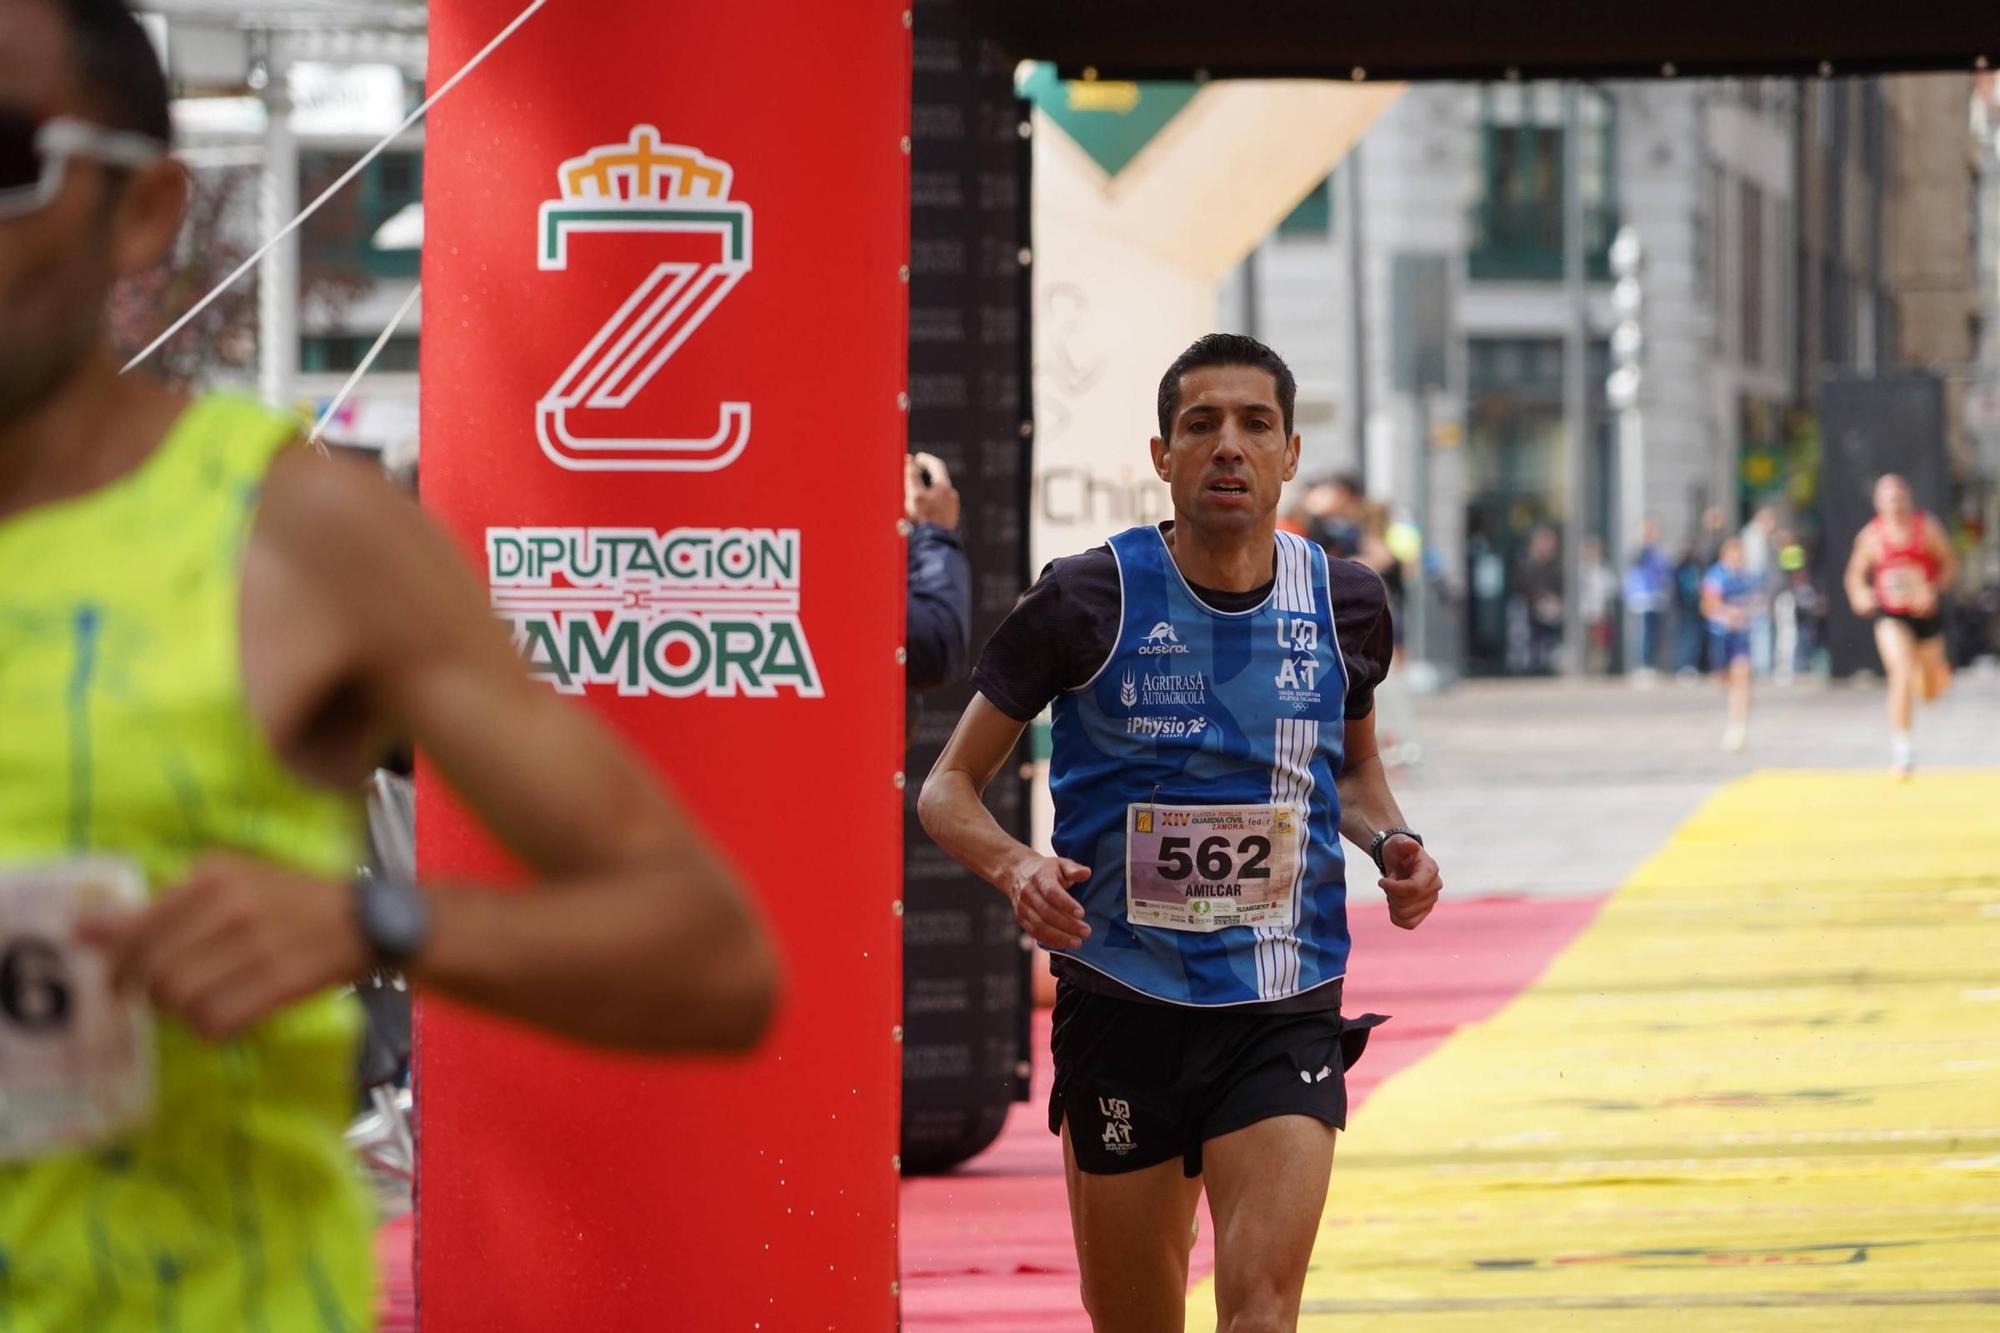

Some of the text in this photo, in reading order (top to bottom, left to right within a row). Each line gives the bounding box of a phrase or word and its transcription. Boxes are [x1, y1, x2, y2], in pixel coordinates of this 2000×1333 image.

[515, 619, 814, 688] AMORA
[1138, 645, 1190, 655] austral
[1142, 671, 1205, 691] AGRITRASA
[1142, 690, 1205, 705] AUTOAGRICOLA
[1127, 716, 1185, 738] iPhysio
[1161, 812, 1191, 826] XIV
[1192, 816, 1224, 824] GUARDIA
[1212, 823, 1244, 831] ZAMORA
[1156, 835, 1271, 881] 562
[1185, 884, 1242, 897] AMILCAR
